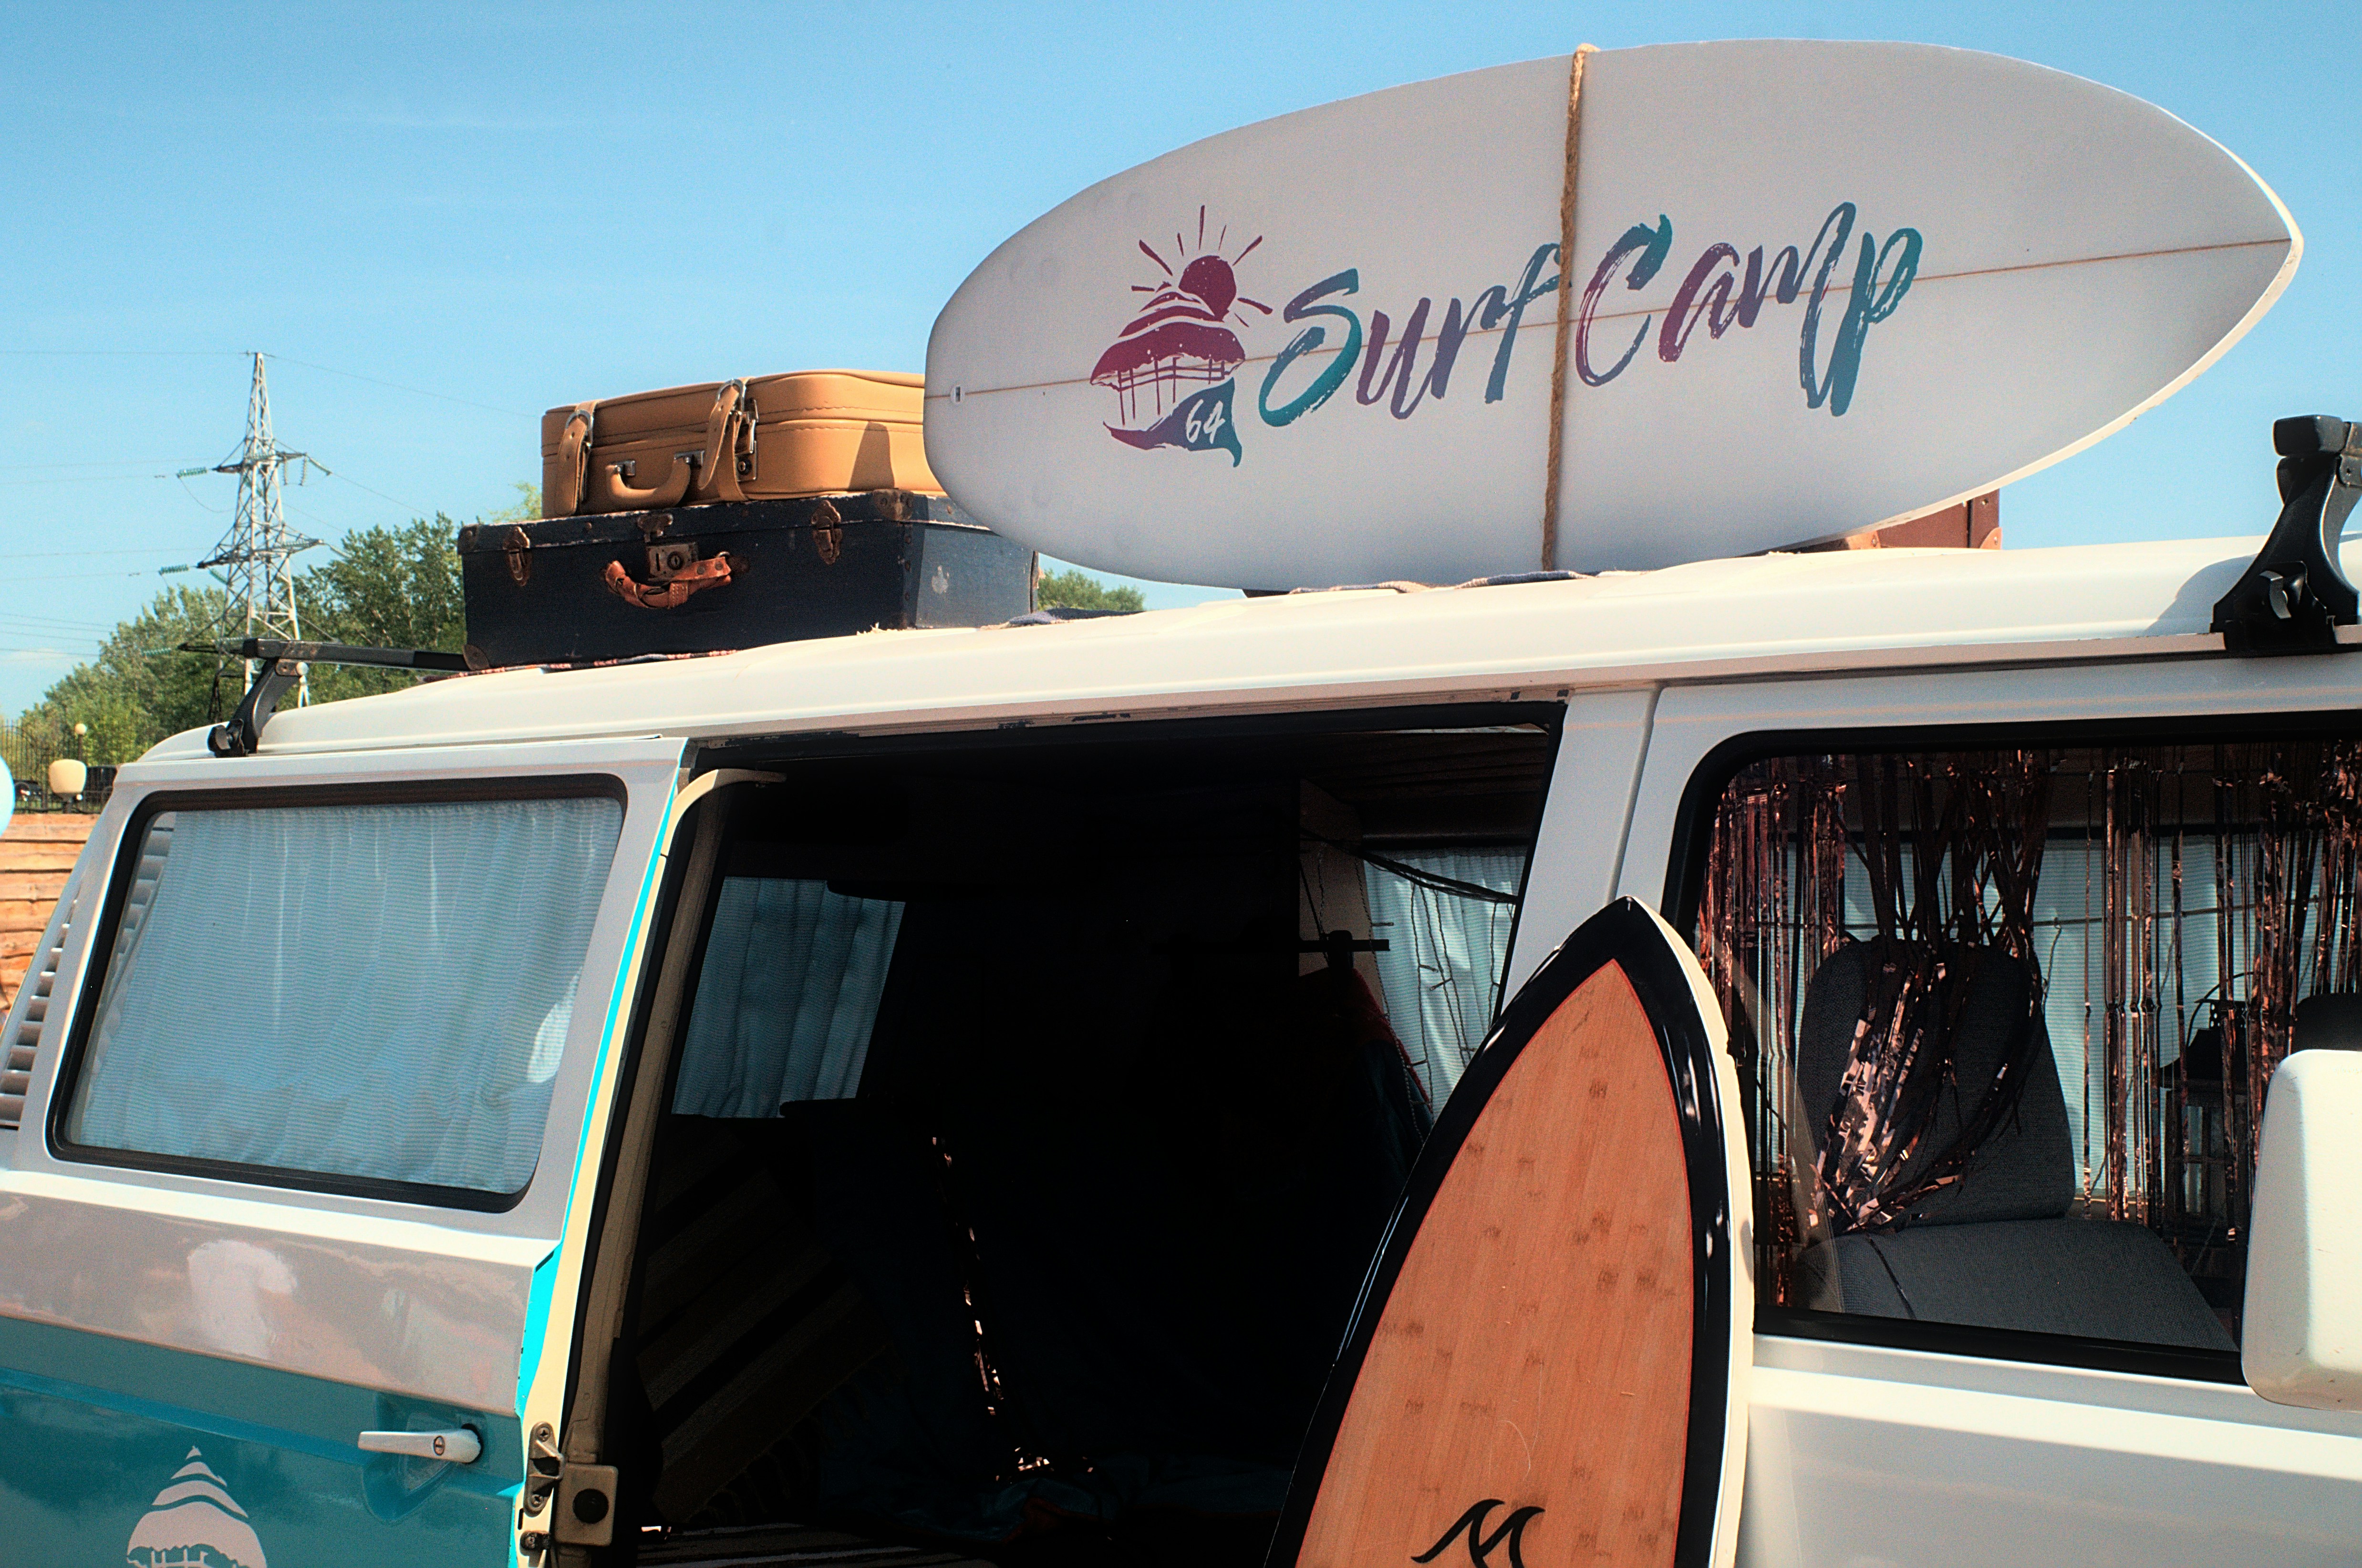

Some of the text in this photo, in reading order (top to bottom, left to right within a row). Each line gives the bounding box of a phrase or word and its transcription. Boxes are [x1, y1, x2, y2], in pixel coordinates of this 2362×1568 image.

[1258, 202, 1923, 427] Surf Camp
[1186, 399, 1225, 444] 64
